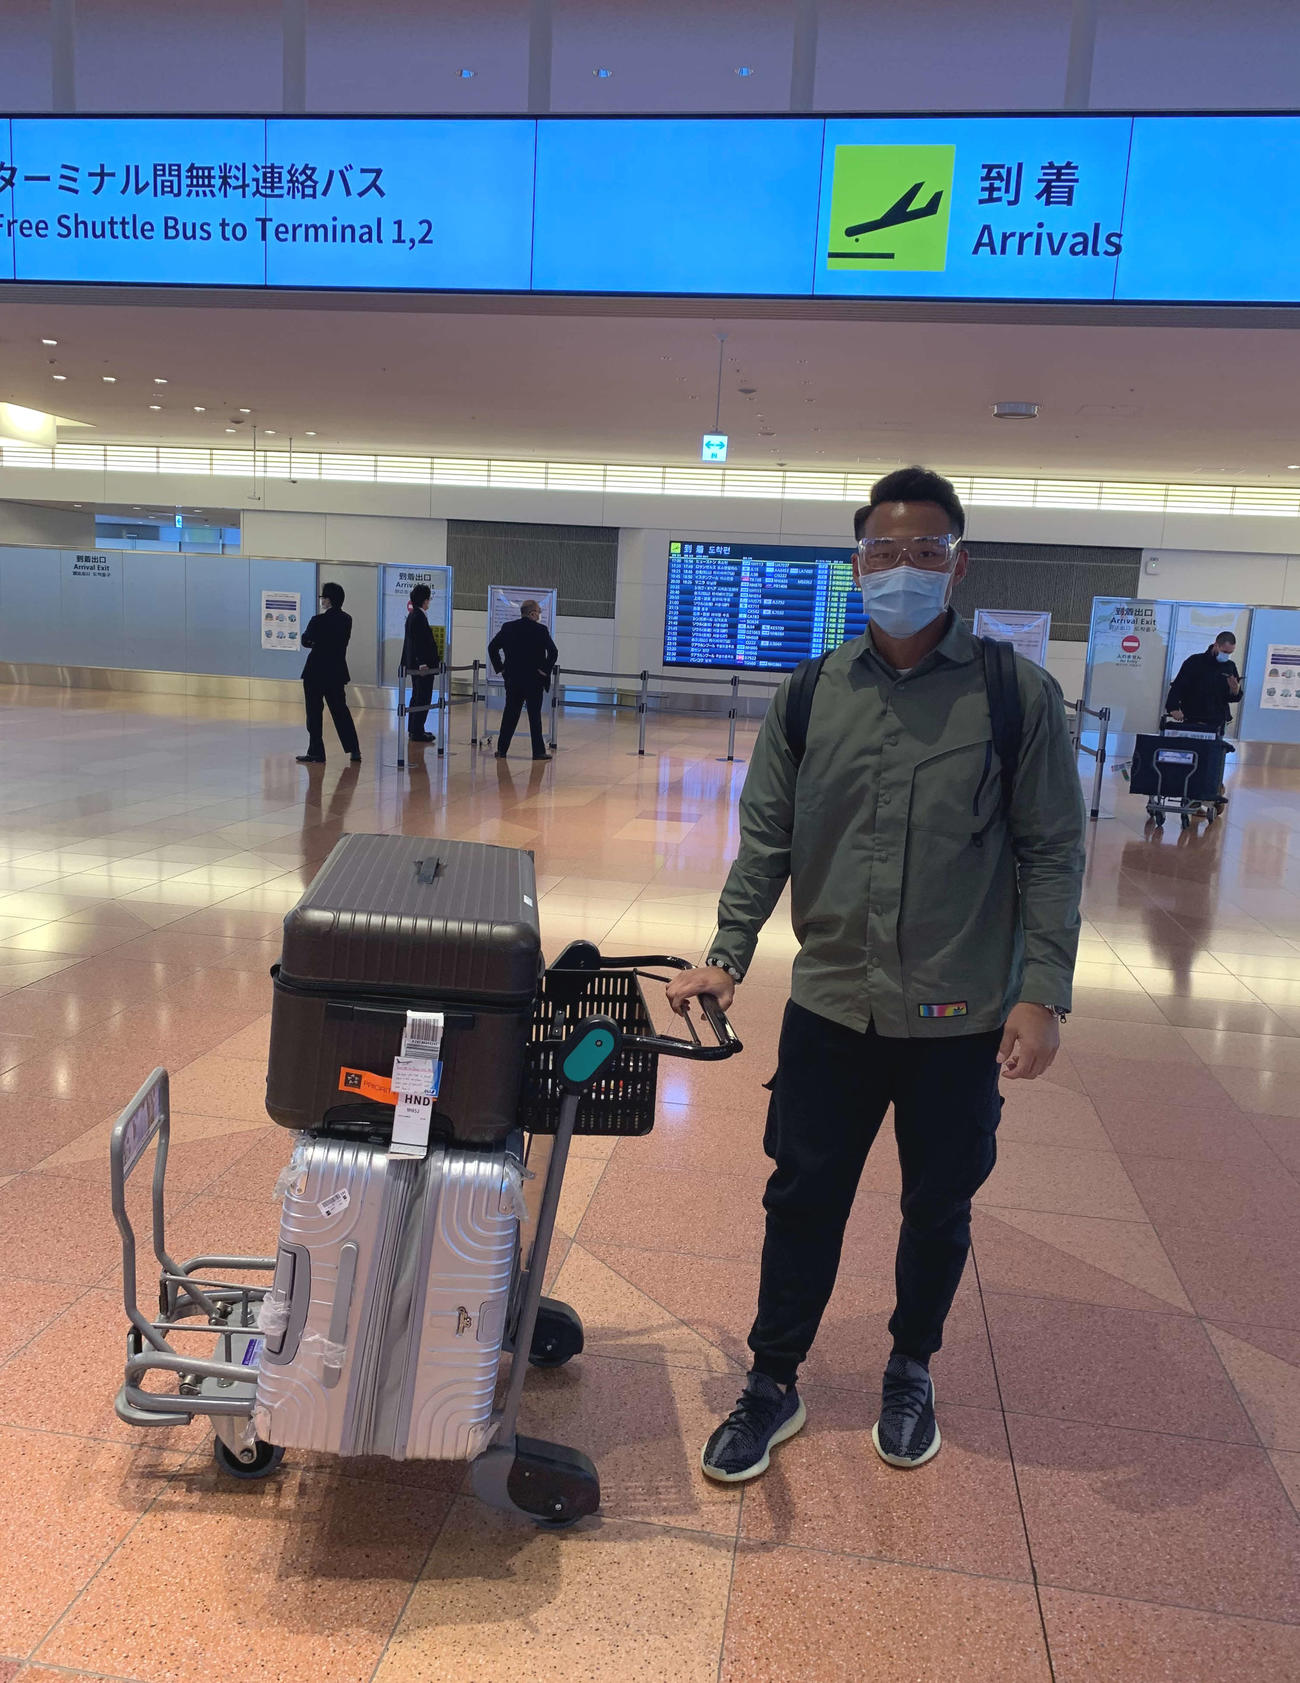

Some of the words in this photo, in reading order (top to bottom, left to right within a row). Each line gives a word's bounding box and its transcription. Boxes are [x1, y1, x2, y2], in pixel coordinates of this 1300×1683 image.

[0, 161, 386, 200] ターミナル間無料連絡バス
[978, 160, 1080, 207] 到着
[0, 213, 49, 239] ree
[56, 212, 155, 240] Shuttle
[163, 215, 212, 241] Bus
[219, 217, 248, 242] to
[255, 216, 384, 244] Terminal
[392, 219, 434, 251] 1,2
[971, 221, 1124, 258] Arrivals
[405, 1094, 431, 1106] HND
